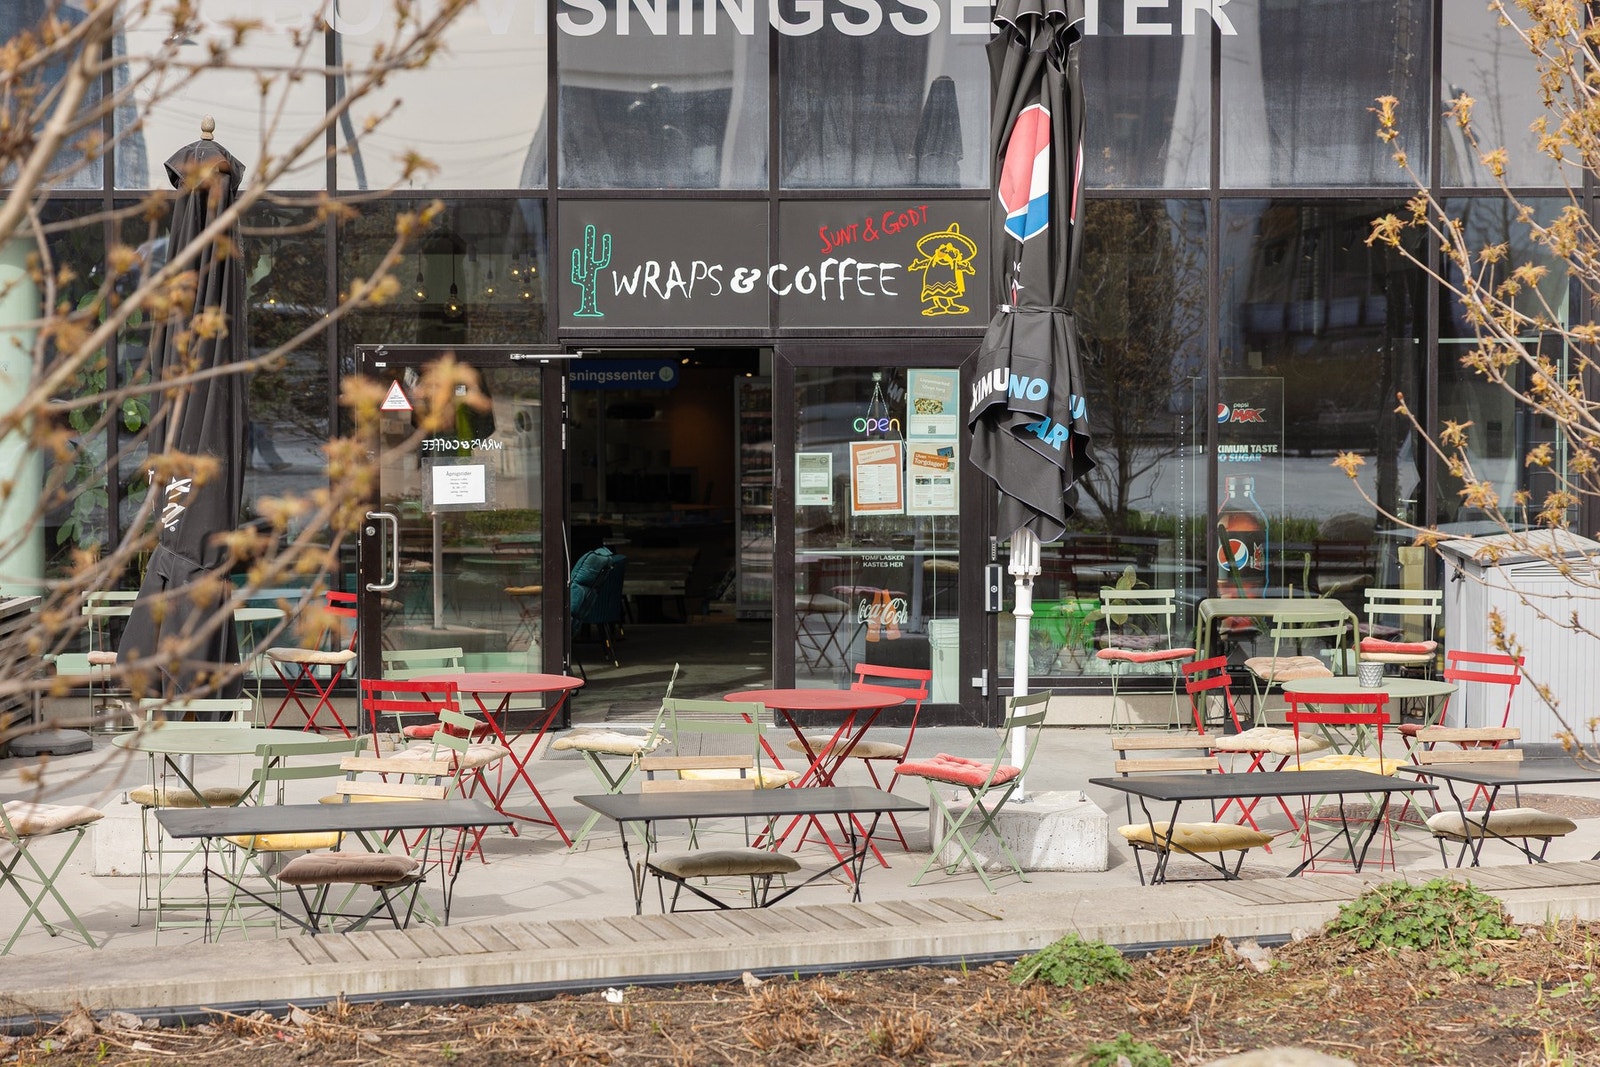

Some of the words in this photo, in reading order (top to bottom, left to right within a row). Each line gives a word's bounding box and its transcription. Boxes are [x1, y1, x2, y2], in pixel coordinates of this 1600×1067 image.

[819, 225, 859, 254] SUNT
[863, 216, 879, 242] &
[881, 205, 928, 235] GODT
[612, 260, 722, 299] WRAPS
[730, 267, 759, 294] &
[767, 257, 902, 300] COFFEE
[569, 370, 655, 384] sningssenter
[1008, 373, 1048, 401] NO
[1230, 408, 1267, 423] MAX
[853, 418, 900, 436] open
[1250, 445, 1278, 453] TASTE
[1228, 453, 1263, 462] SUGAR
